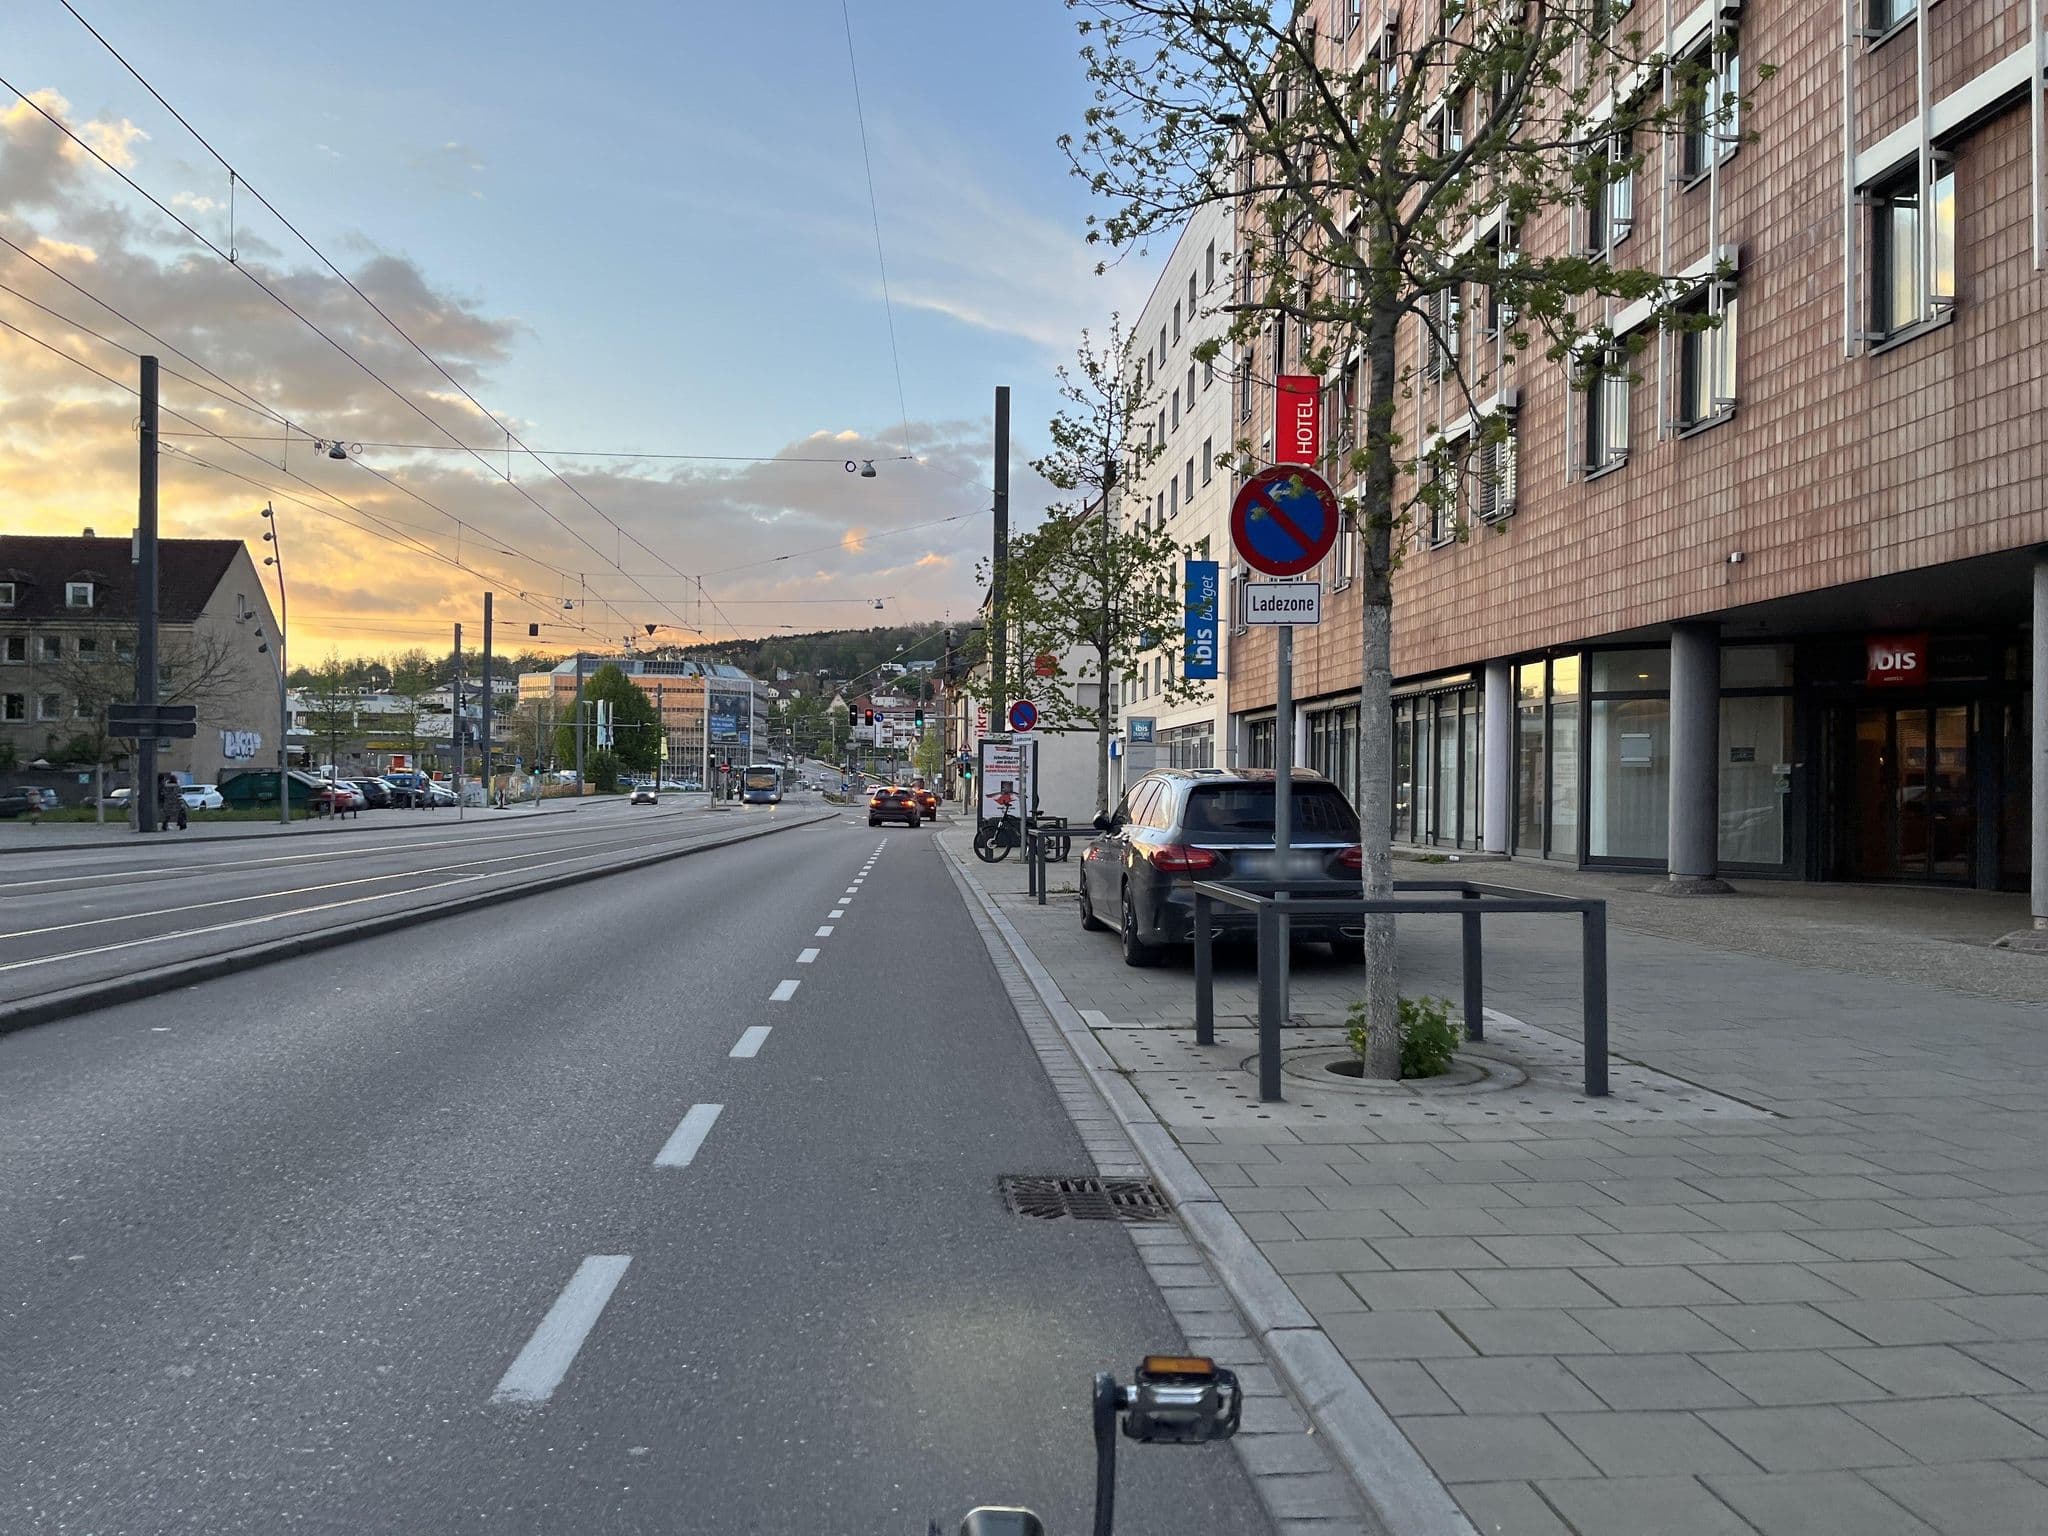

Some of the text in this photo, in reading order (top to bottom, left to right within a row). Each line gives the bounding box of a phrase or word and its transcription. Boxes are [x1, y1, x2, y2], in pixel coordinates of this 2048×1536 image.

[1296, 397, 1313, 454] HOTEL
[1252, 595, 1314, 611] Ladezone
[1191, 628, 1213, 665] ibis
